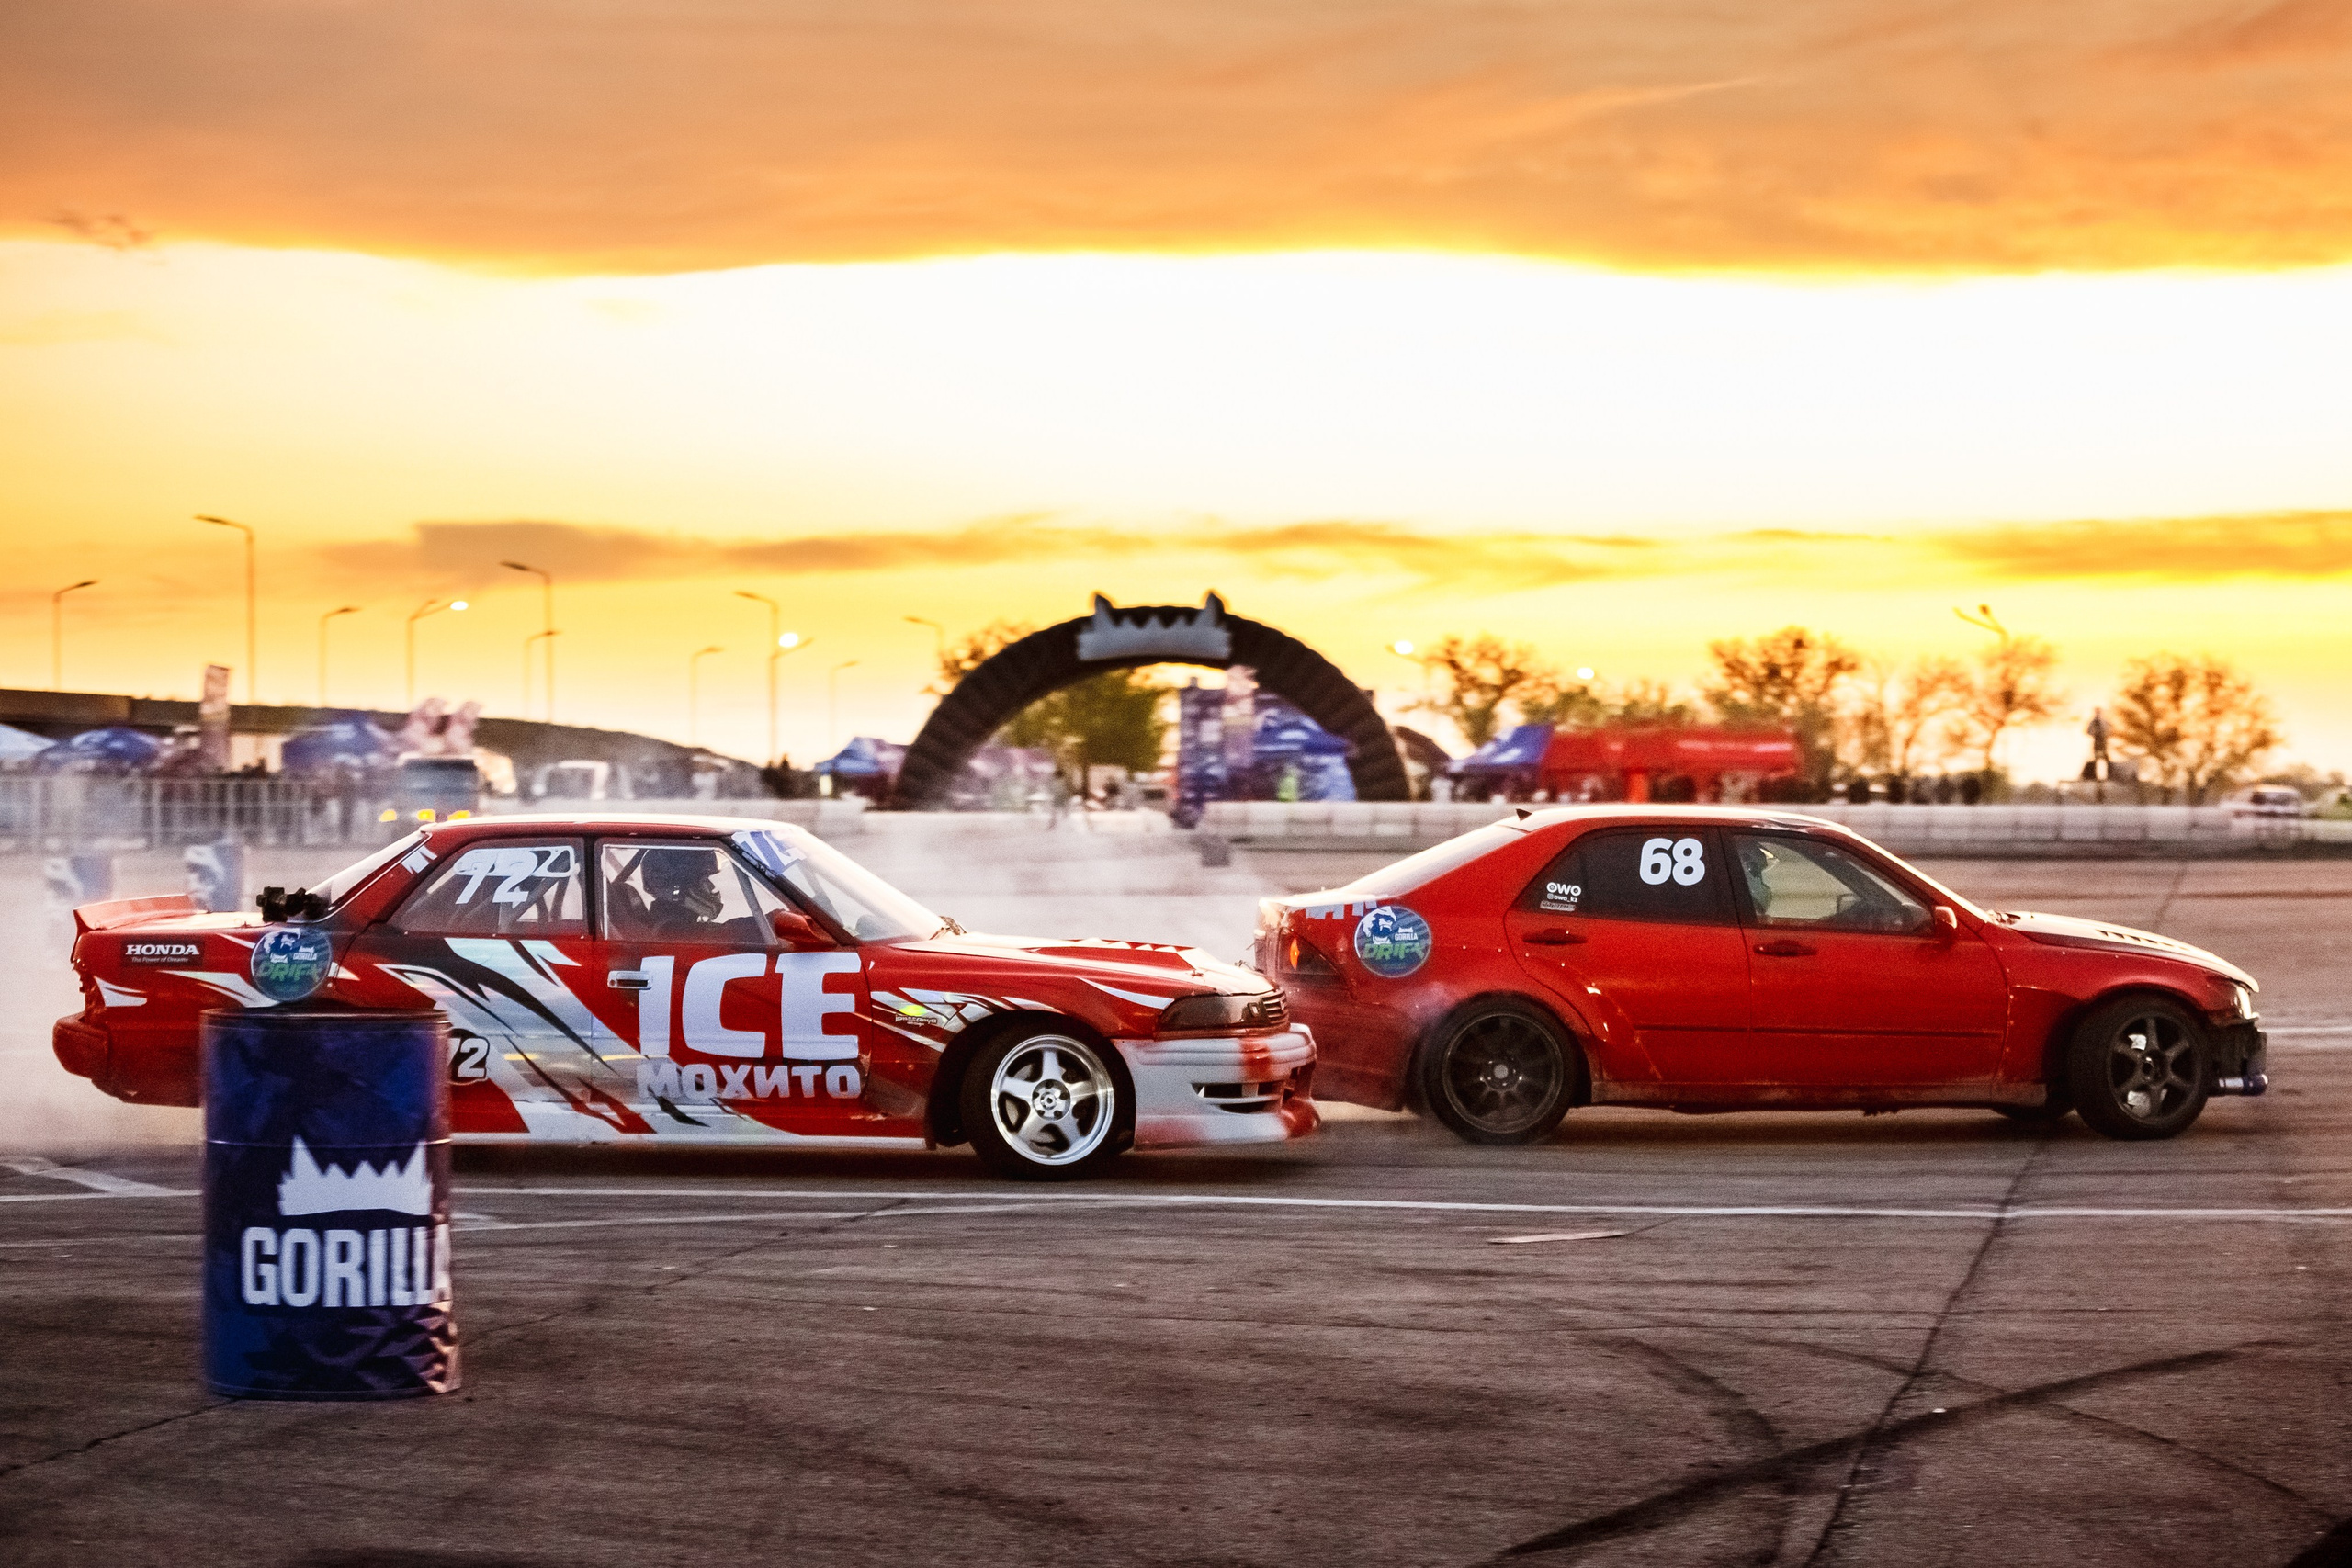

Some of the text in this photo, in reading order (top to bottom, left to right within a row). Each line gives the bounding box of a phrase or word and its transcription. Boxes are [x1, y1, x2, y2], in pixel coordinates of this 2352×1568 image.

[1639, 838, 1705, 886] 68
[455, 849, 538, 905] 72
[1395, 932, 1418, 941] GORILLA
[125, 944, 200, 955] HONDA
[292, 952, 317, 961] GORILLA
[1363, 942, 1424, 960] DRIFT
[257, 961, 320, 982] DRIFT
[639, 952, 862, 1061] ICE
[636, 1063, 862, 1099] МОХИТО
